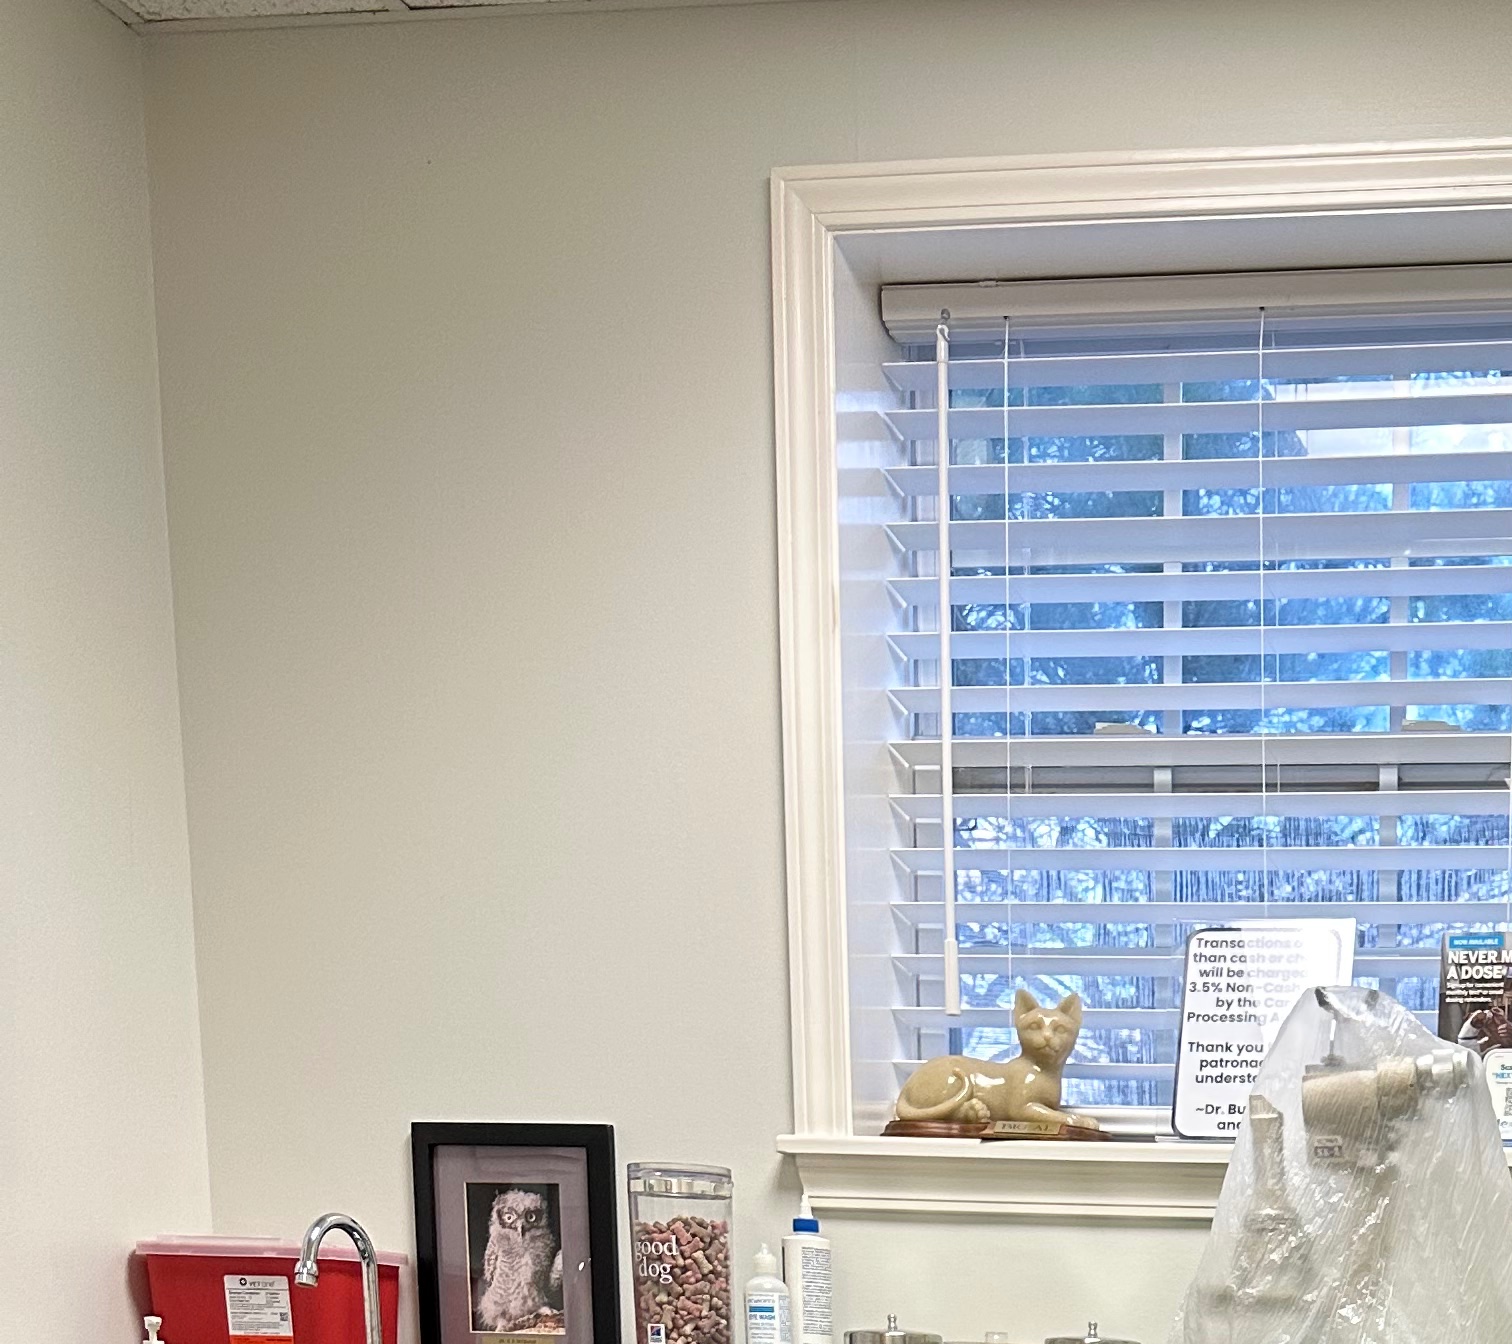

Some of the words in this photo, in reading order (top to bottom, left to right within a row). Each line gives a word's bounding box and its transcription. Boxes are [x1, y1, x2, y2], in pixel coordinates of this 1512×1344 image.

[1196, 936, 1291, 949] Transactions
[1193, 952, 1227, 963] than
[1230, 952, 1266, 964] cash
[1448, 950, 1498, 964] NEVER
[1198, 966, 1223, 978] will
[1227, 967, 1245, 978] be
[1446, 965, 1459, 980] A
[1461, 965, 1503, 980] DOSE
[1189, 982, 1222, 993] 3.5%
[1216, 997, 1234, 1011] by
[1237, 997, 1261, 1008] the
[1264, 997, 1291, 1008] Car
[1187, 1011, 1267, 1026] Processing
[1188, 1041, 1233, 1053] Thank
[1237, 1043, 1264, 1056] you
[1228, 1104, 1247, 1115] Bu
[635, 1235, 680, 1261] good
[639, 1256, 673, 1284] dog
